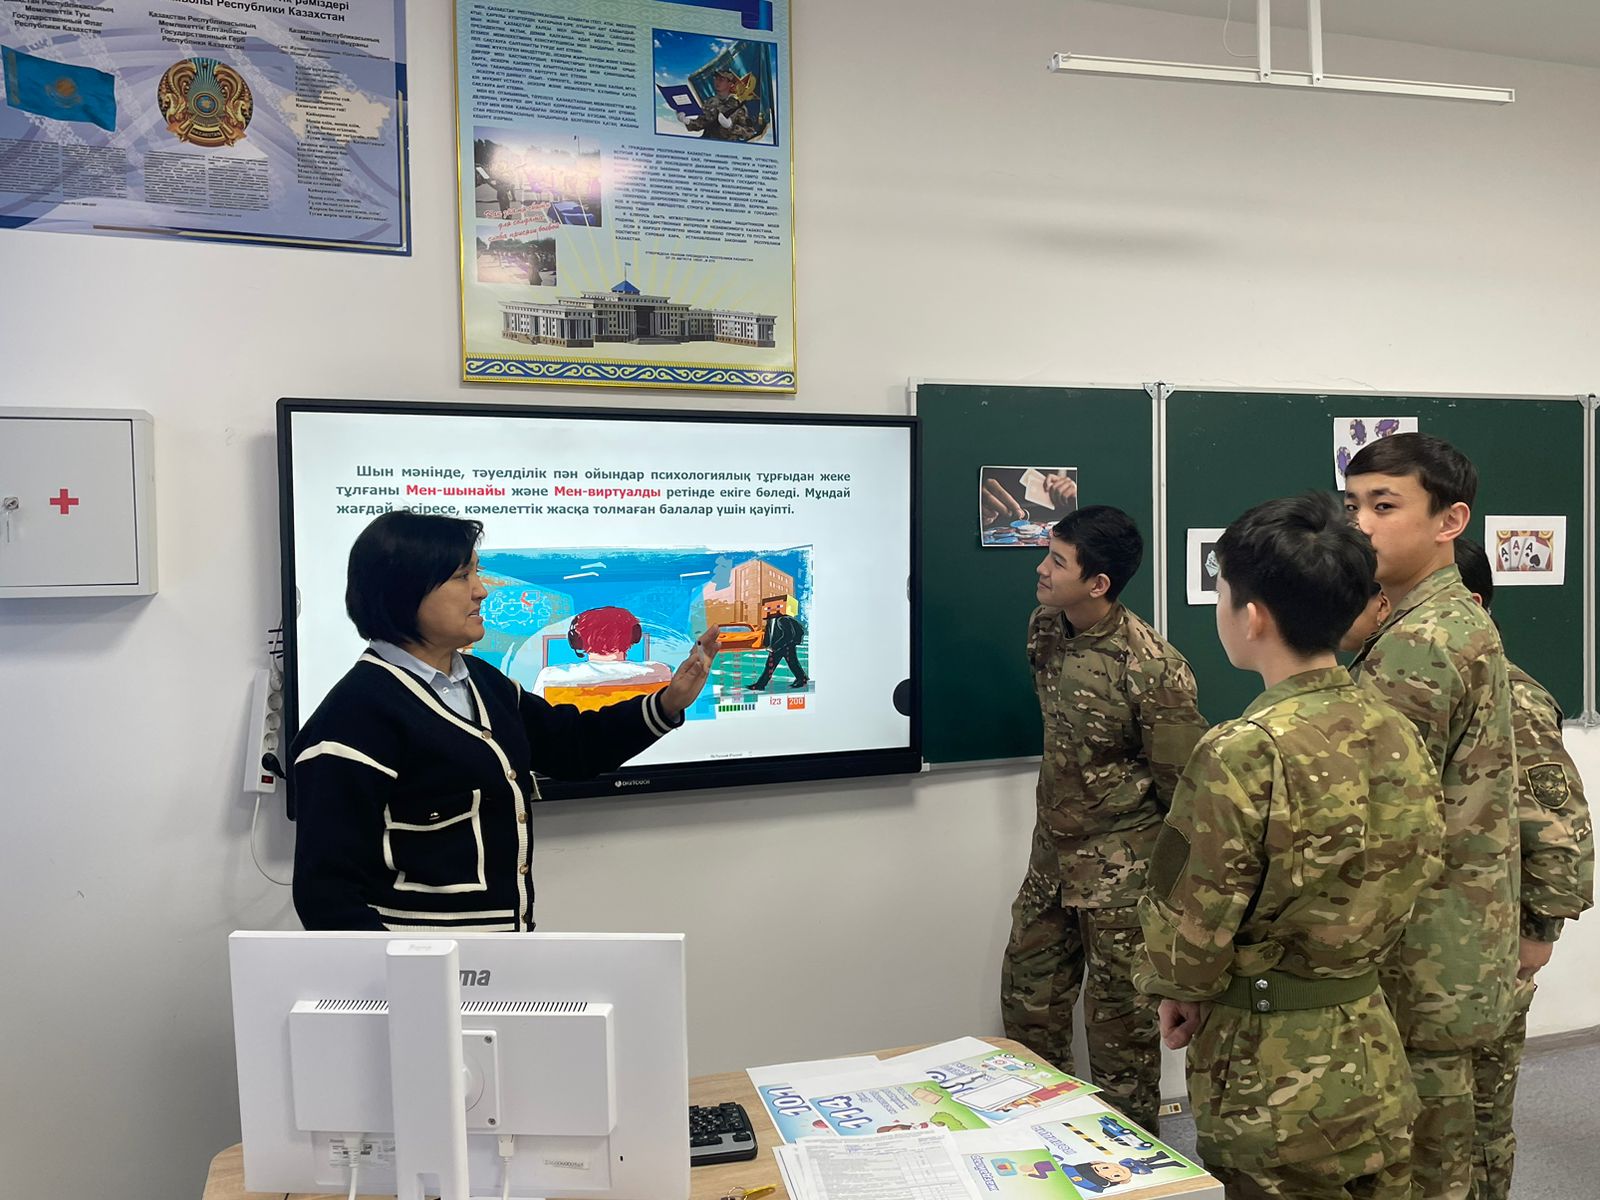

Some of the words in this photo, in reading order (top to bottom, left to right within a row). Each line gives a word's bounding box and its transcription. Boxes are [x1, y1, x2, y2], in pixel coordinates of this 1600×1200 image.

[217, 0, 285, 14] Республики
[289, 6, 344, 21] Казахстан
[356, 465, 394, 477] Шын
[401, 465, 465, 480] мәнінде,
[472, 467, 547, 480] тәуелділік
[553, 470, 578, 479] пән
[584, 468, 645, 482] ойындар
[650, 471, 751, 483] психологиялық
[756, 472, 815, 485] тұрғыдан
[820, 473, 851, 482] жеке
[336, 486, 400, 498] тұлғаны
[406, 484, 506, 496] Мен-шынайы
[511, 487, 549, 497] және
[554, 485, 661, 499] Мен-виртуалды
[666, 487, 715, 499] ретінде
[720, 486, 752, 498] екіге
[756, 486, 800, 500] бөледі.
[804, 486, 851, 500] Мұндай
[336, 502, 394, 515] жағдай
[464, 503, 543, 515] кәмелеттік
[547, 505, 590, 516] жасқа
[594, 505, 656, 516] толмаған
[660, 504, 713, 517] балалар
[717, 504, 746, 517] үшін
[750, 504, 795, 517] қауіпті.
[1501, 547, 1508, 558] A
[1513, 540, 1520, 550] A
[1526, 542, 1533, 552] A
[459, 969, 491, 986] ma
